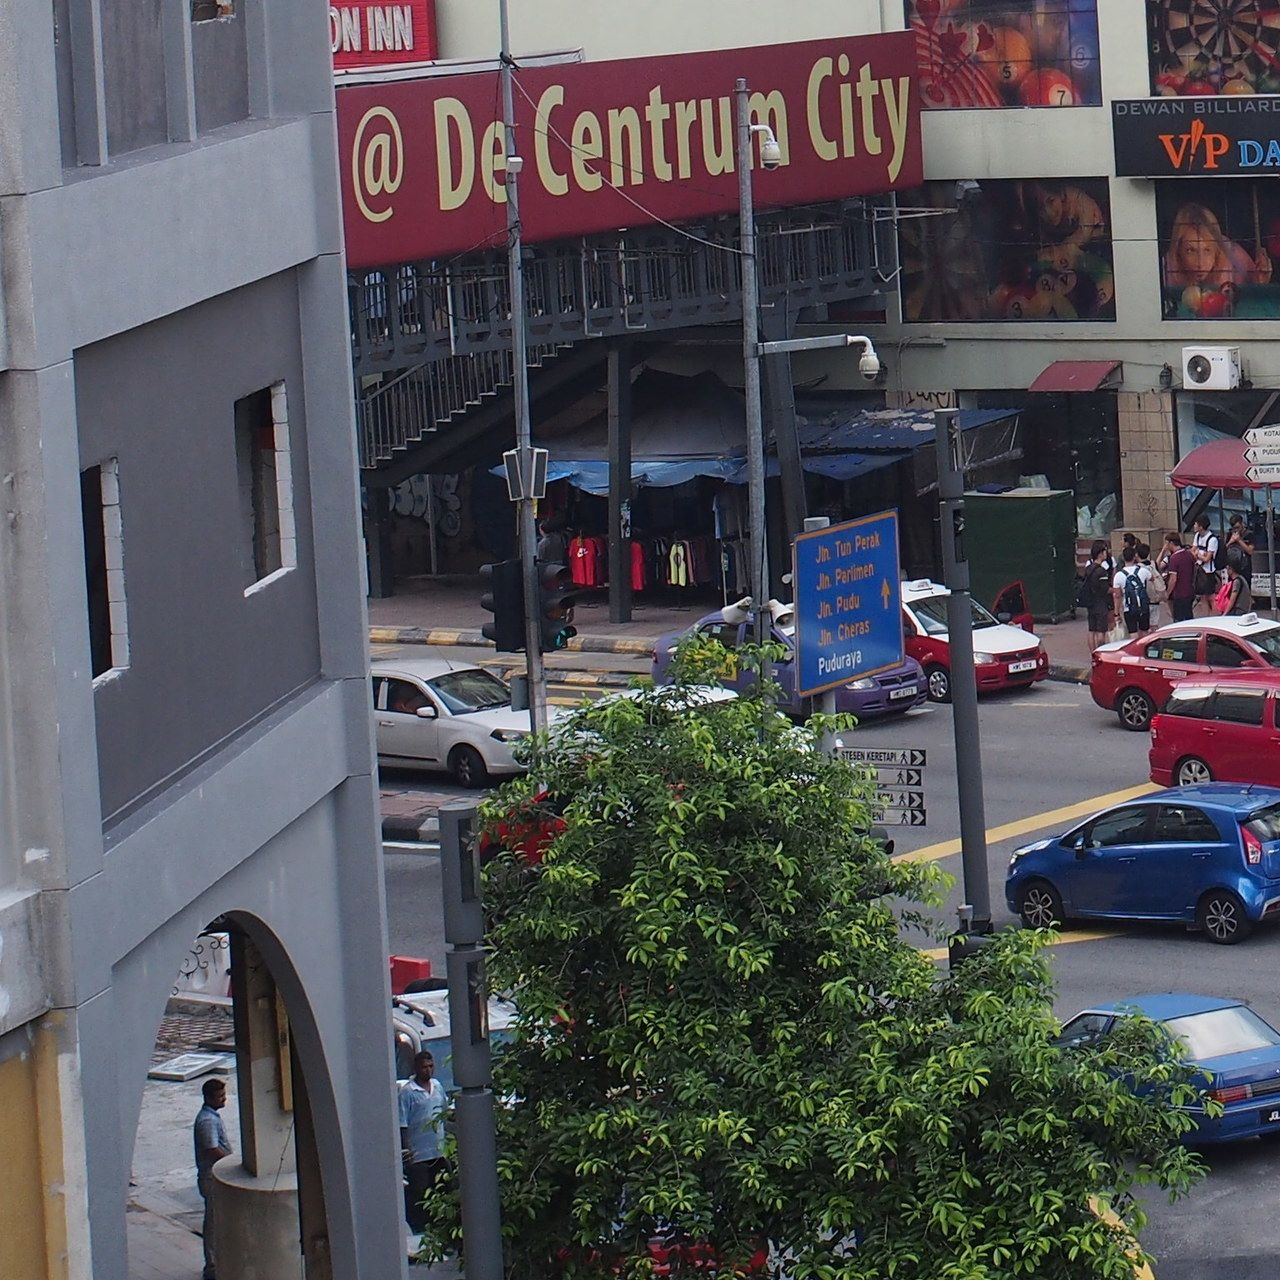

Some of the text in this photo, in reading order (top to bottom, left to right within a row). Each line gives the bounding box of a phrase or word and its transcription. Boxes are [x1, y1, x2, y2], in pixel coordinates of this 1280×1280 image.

[367, 5, 413, 51] INN
[1056, 90, 1066, 105] 7
[1115, 101, 1184, 116] DEWAN
[434, 97, 511, 211] De
[535, 84, 790, 197] Centrum
[807, 53, 910, 183] City
[835, 541, 852, 559] Tun
[855, 532, 881, 553] Perak
[835, 563, 874, 586] Parlimen
[836, 594, 860, 614] Pudu
[837, 620, 870, 641] Cheras
[818, 649, 862, 676] Puduraya
[841, 750, 896, 762] STESEN KERETAPI
